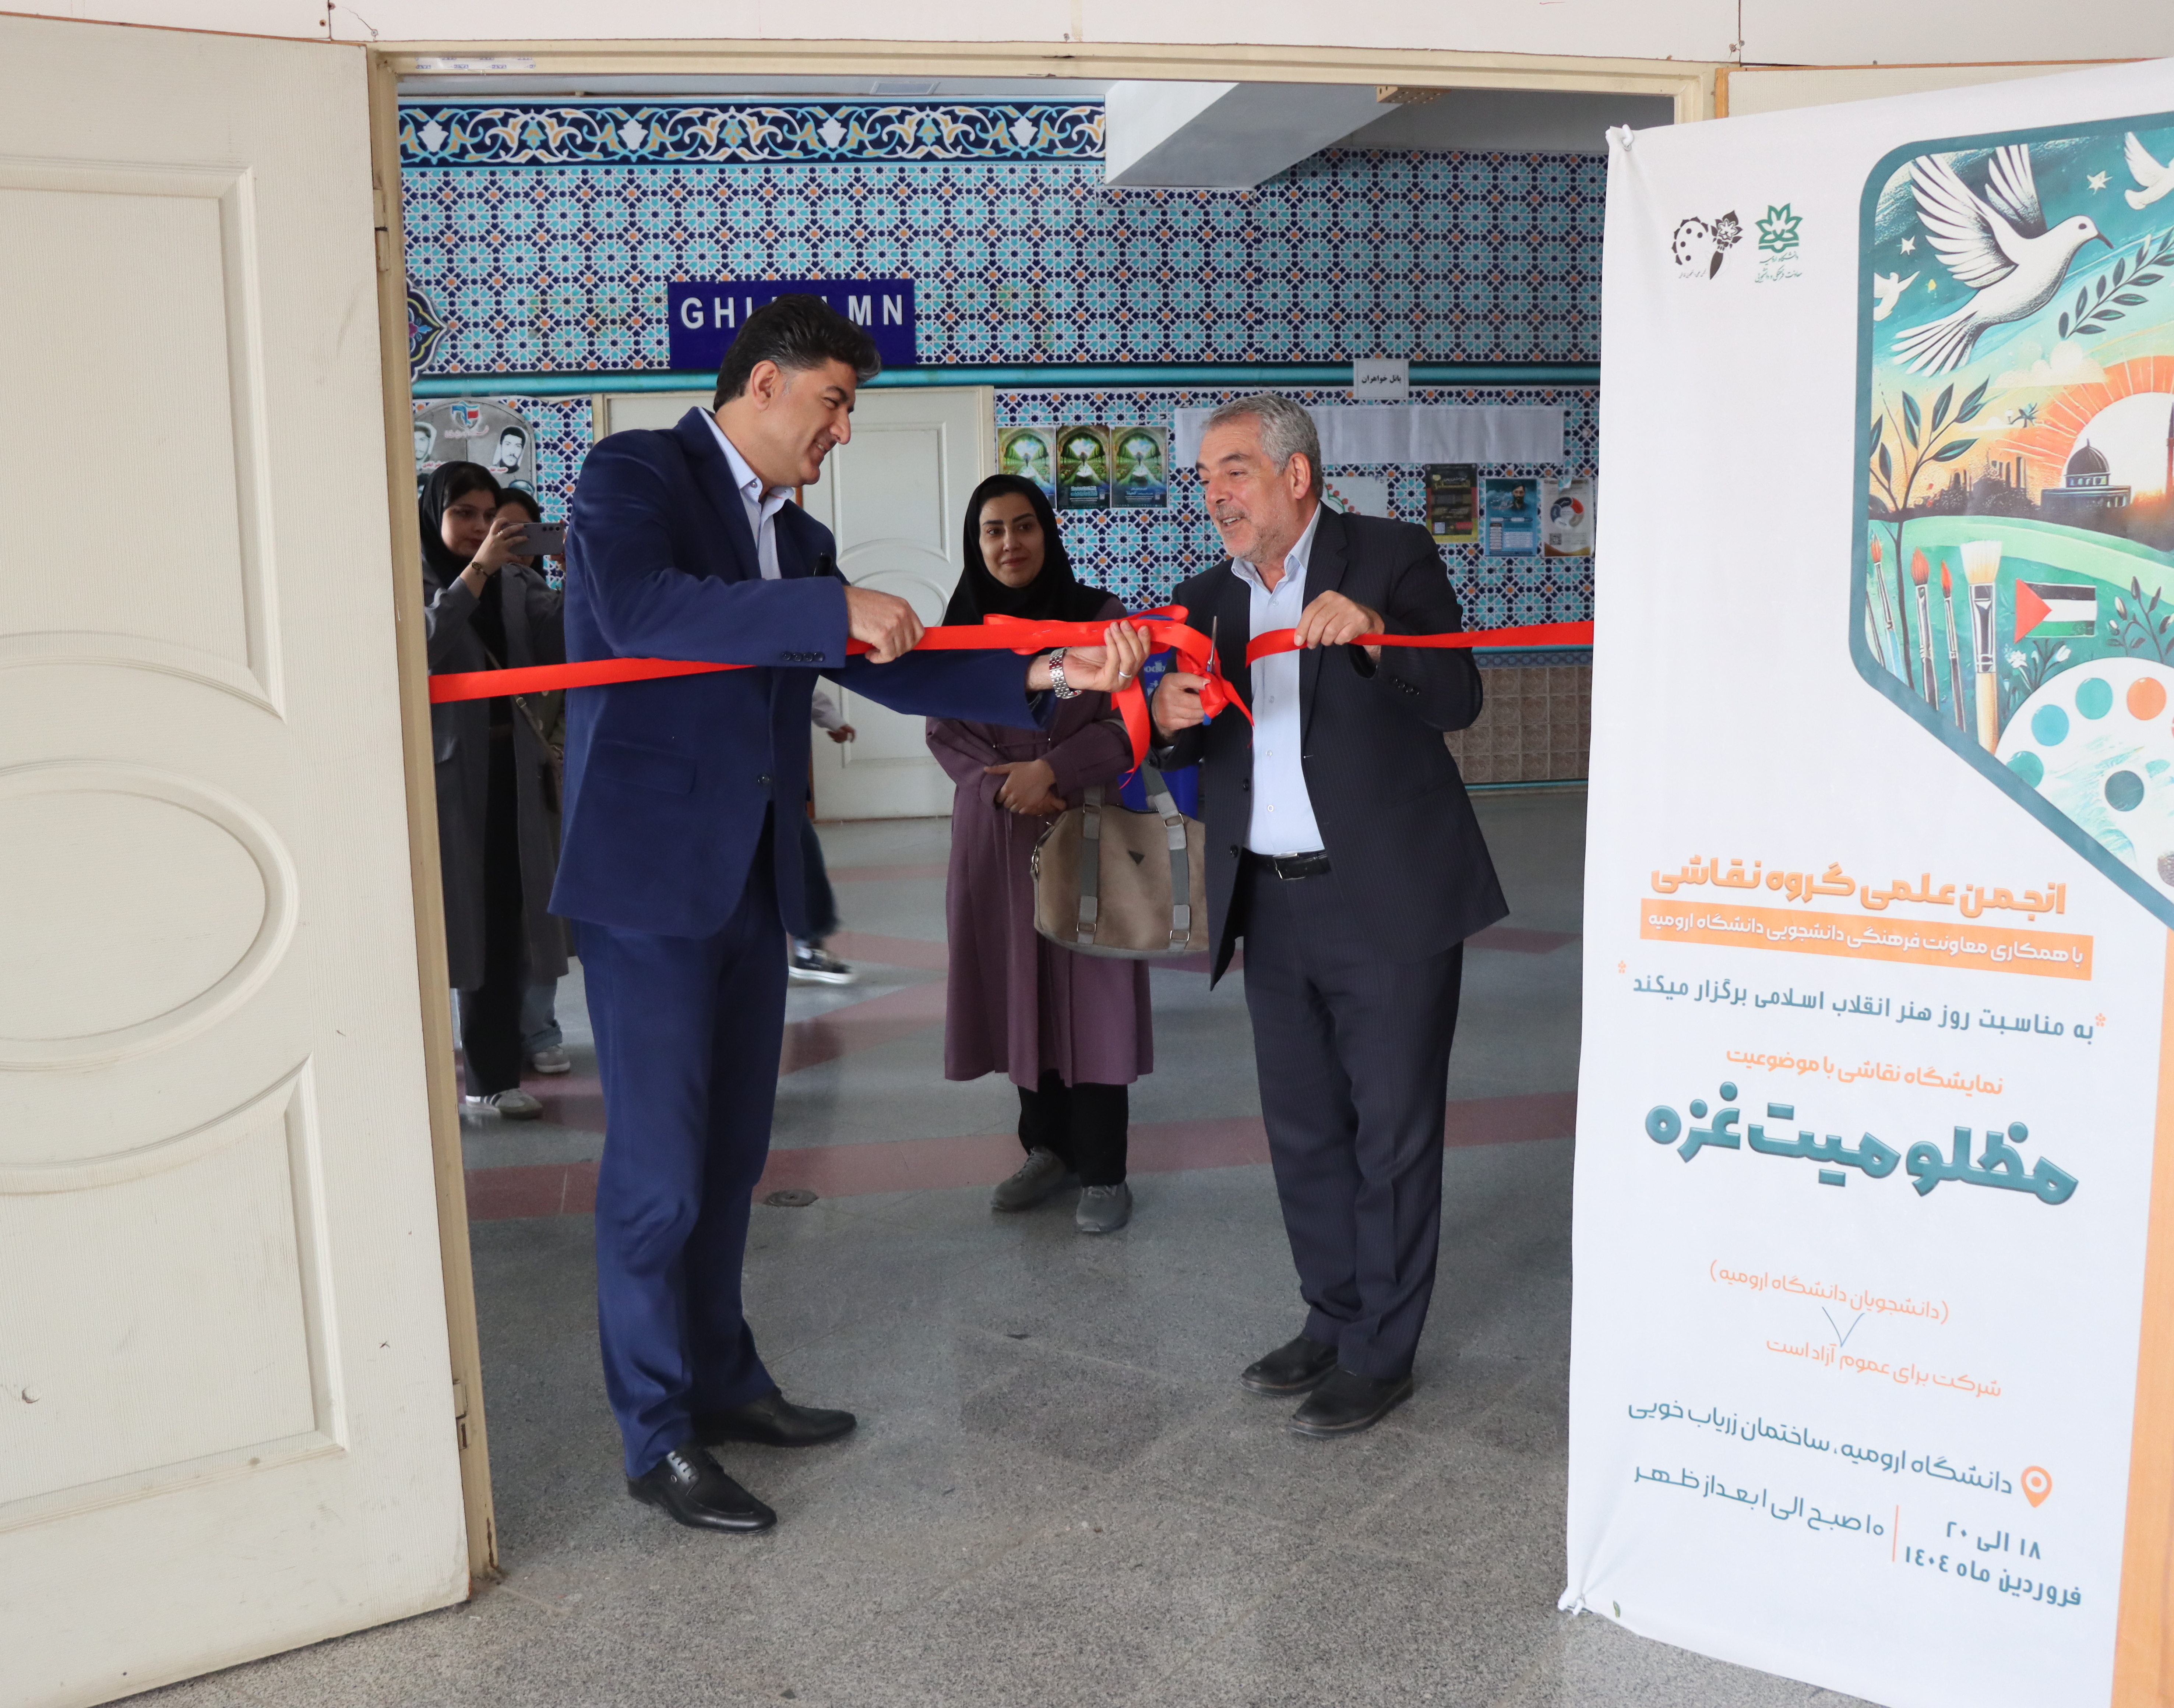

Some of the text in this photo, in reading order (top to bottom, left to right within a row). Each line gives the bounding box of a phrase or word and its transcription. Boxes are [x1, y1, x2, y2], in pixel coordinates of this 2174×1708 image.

[1361, 374, 1388, 384] خواهران
[1651, 854, 2066, 922] انجمن علمی گروه نقاشی
[1648, 913, 2084, 968] با همکاری معاونت فرهنگی دانشجویی دانشگاه ارومیه
[1633, 975, 2093, 1045] به مناسبت روز هنر انقلاب اسلامی برگزار میکند
[1726, 1051, 2003, 1097] نمایشگاه نقاشی با موضوعیت
[1645, 1081, 2079, 1206] مظلومیت غزه
[1772, 1275, 1847, 1302] دانشگاه
[1766, 1341, 2001, 1398] شرکت برای عموم آزاد است
[1628, 1400, 1684, 1421] خویی
[1688, 1407, 1737, 1436] زریاب
[1741, 1417, 1830, 1451] ساختمان
[1911, 1455, 2012, 1494] دانشگاه
[1770, 1496, 1804, 1521] الی
[1807, 1507, 1862, 1531] صبح
[1977, 1530, 2009, 1552] الی
[1956, 1560, 1990, 1582] ماه
[1998, 1568, 2082, 1608] فروردین
